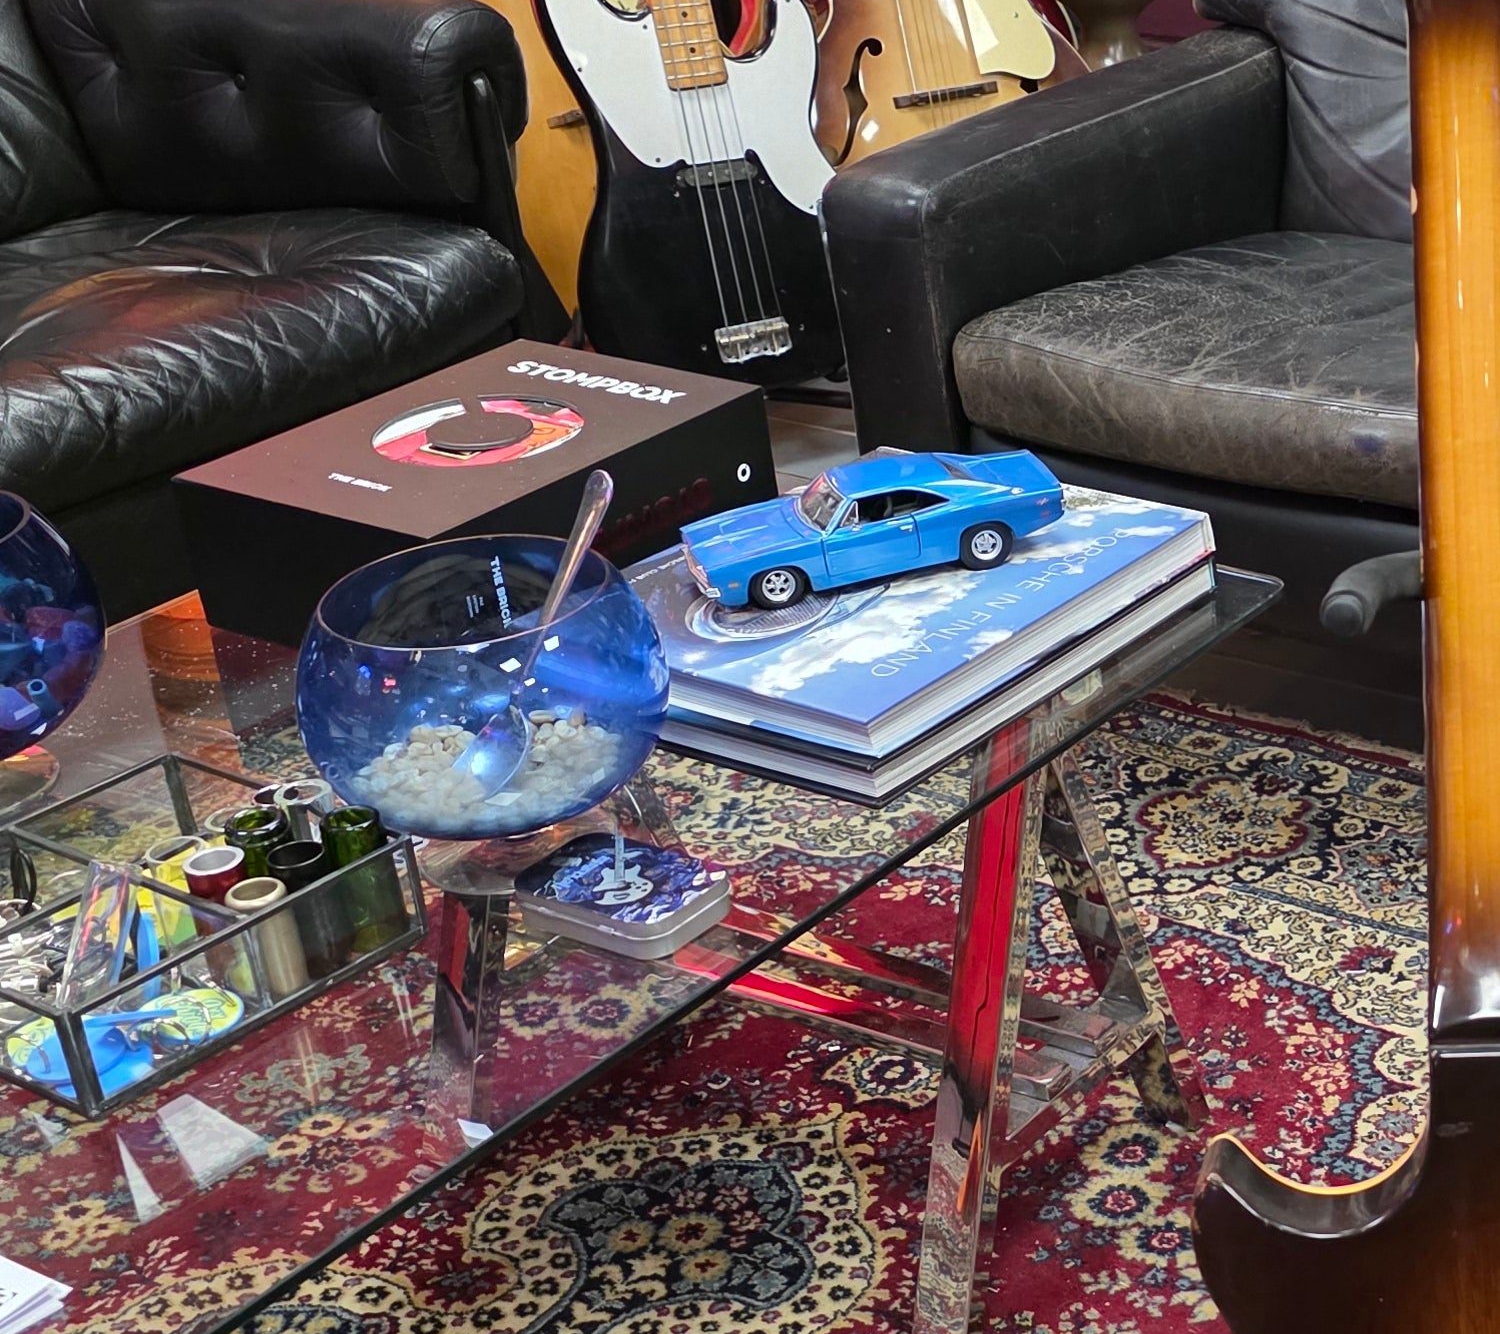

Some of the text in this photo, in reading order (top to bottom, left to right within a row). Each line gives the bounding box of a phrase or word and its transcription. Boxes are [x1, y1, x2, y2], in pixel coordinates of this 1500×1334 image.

[507, 360, 686, 405] STOMPBOX
[491, 556, 503, 586] THE
[870, 529, 1136, 678] PORSCHE IN FINLAND
